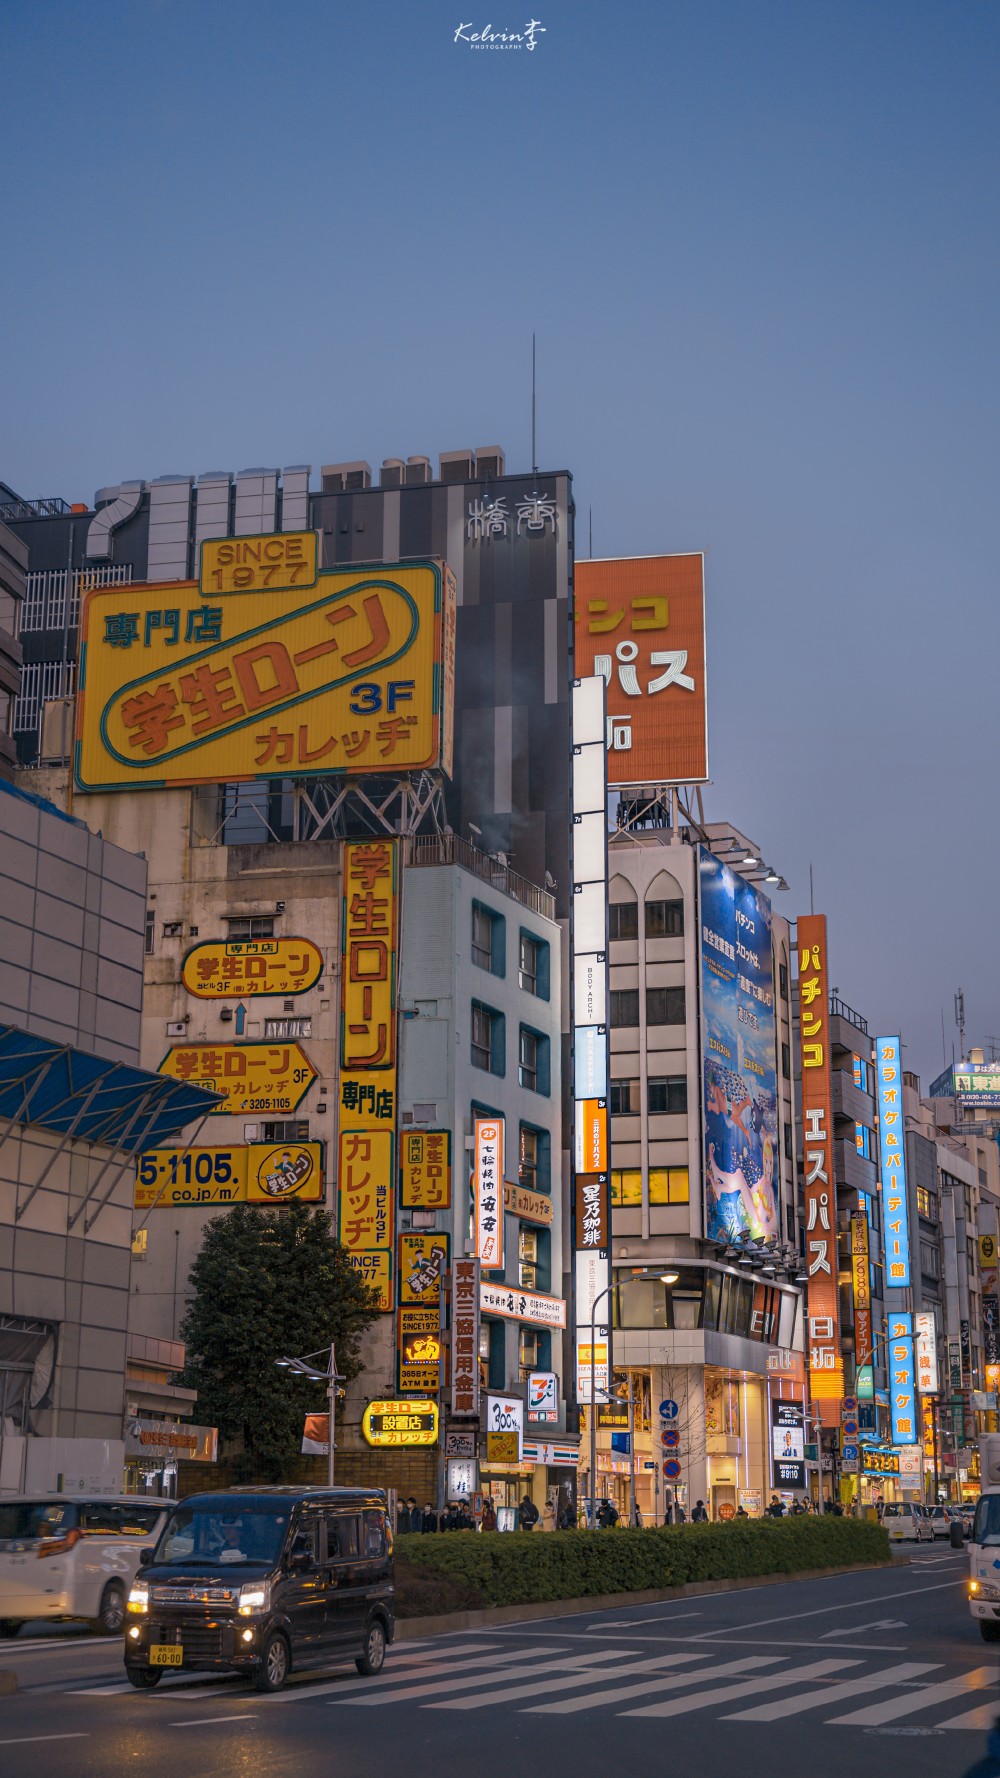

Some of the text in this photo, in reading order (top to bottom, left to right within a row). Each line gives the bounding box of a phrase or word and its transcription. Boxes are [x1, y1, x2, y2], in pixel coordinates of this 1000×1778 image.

[217, 539, 303, 565] SINCE
[211, 562, 308, 590] 1977
[103, 606, 223, 649] 専門店
[120, 594, 391, 755] 学生ローン
[350, 680, 415, 716] 3F
[735, 909, 755, 934] パチンコ
[196, 954, 310, 981] 学生ローン
[349, 844, 391, 1066] 学生ローン
[216, 982, 231, 992] 3F
[800, 945, 824, 1068] パチンコ
[175, 1049, 290, 1079] 学生ローン
[293, 1069, 309, 1084] 3F
[249, 1098, 291, 1110] 3205-1105
[341, 1081, 393, 1119] 専門店
[482, 1130, 495, 1138] 2F
[267, 1157, 309, 1194] 学生ローン
[427, 1136, 443, 1203] 学生ローン
[805, 1108, 831, 1275] エスパス
[582, 1184, 600, 1247] 星乃珈琲
[411, 1248, 444, 1293] 学生ローン
[455, 1262, 475, 1412] 東京三協信用金庫
[810, 1316, 835, 1369] 日拓
[858, 1321, 869, 1357] アイフル
[893, 1323, 912, 1433] カラオケ館
[372, 1403, 433, 1413] 学生ローン
[382, 1416, 422, 1431] 設置店
[157, 1653, 181, 1664] 60-00
